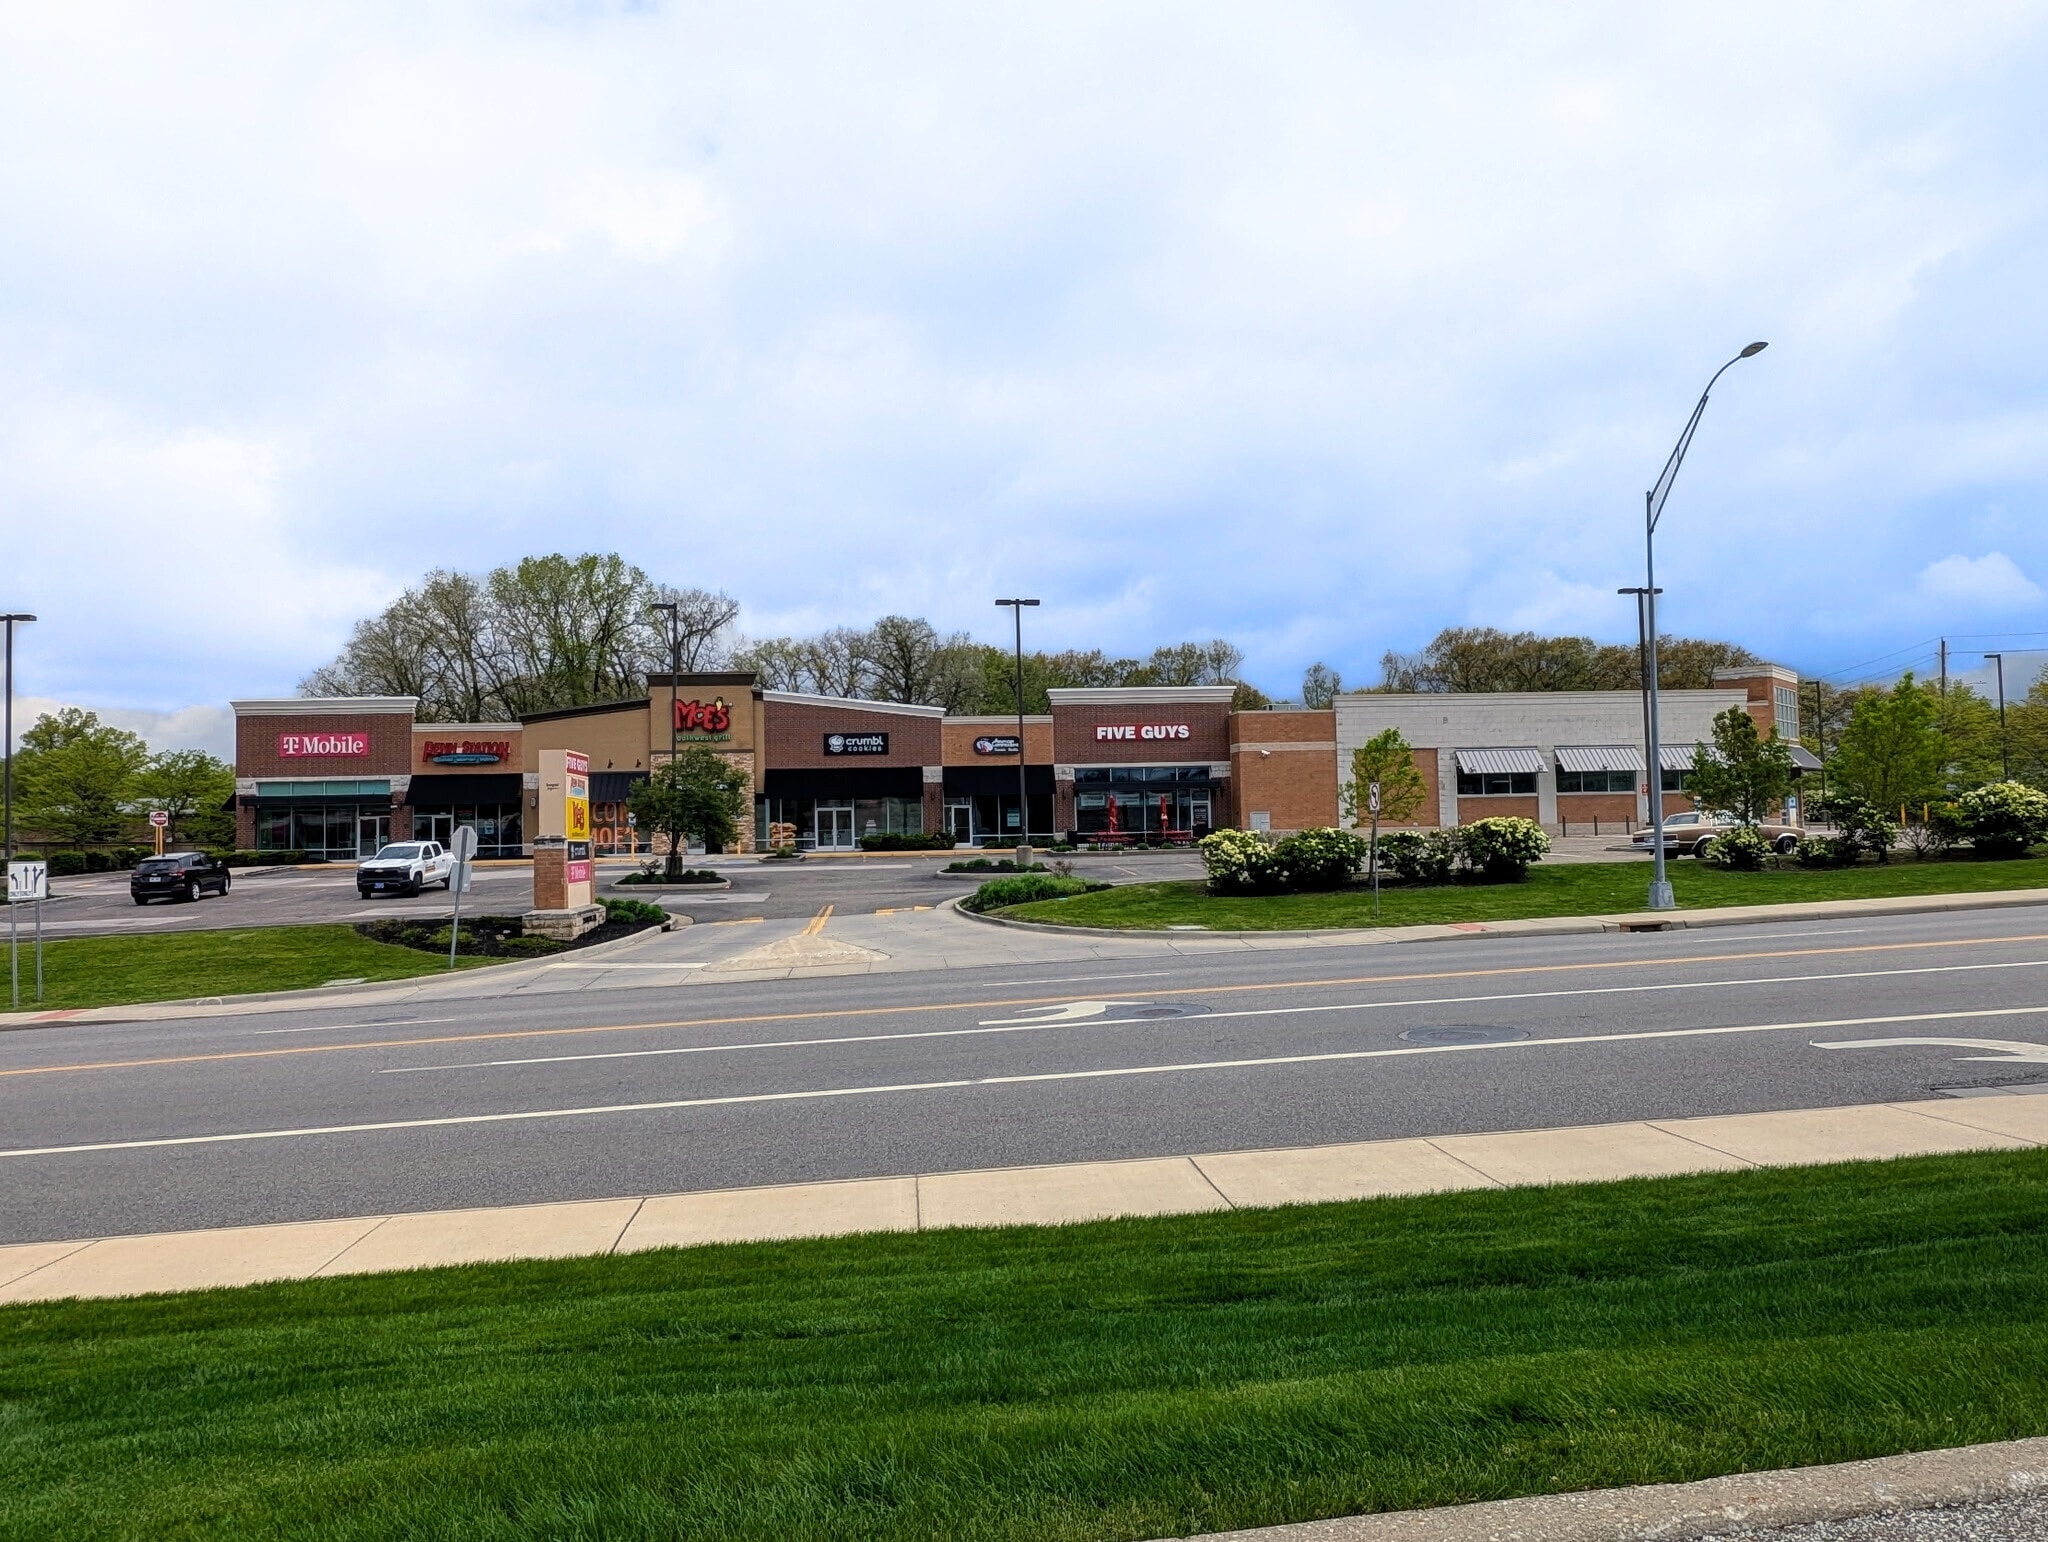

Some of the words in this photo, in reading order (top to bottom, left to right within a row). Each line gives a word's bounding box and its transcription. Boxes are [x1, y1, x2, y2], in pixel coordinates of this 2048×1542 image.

[676, 734, 712, 742] outhwest
[1096, 726, 1136, 740] FIVE
[1140, 725, 1190, 739] GUYS
[283, 736, 299, 755] T
[301, 735, 364, 754] Mobile
[845, 735, 884, 746] crumbl
[423, 741, 457, 762] PENN
[461, 741, 511, 762] STATION
